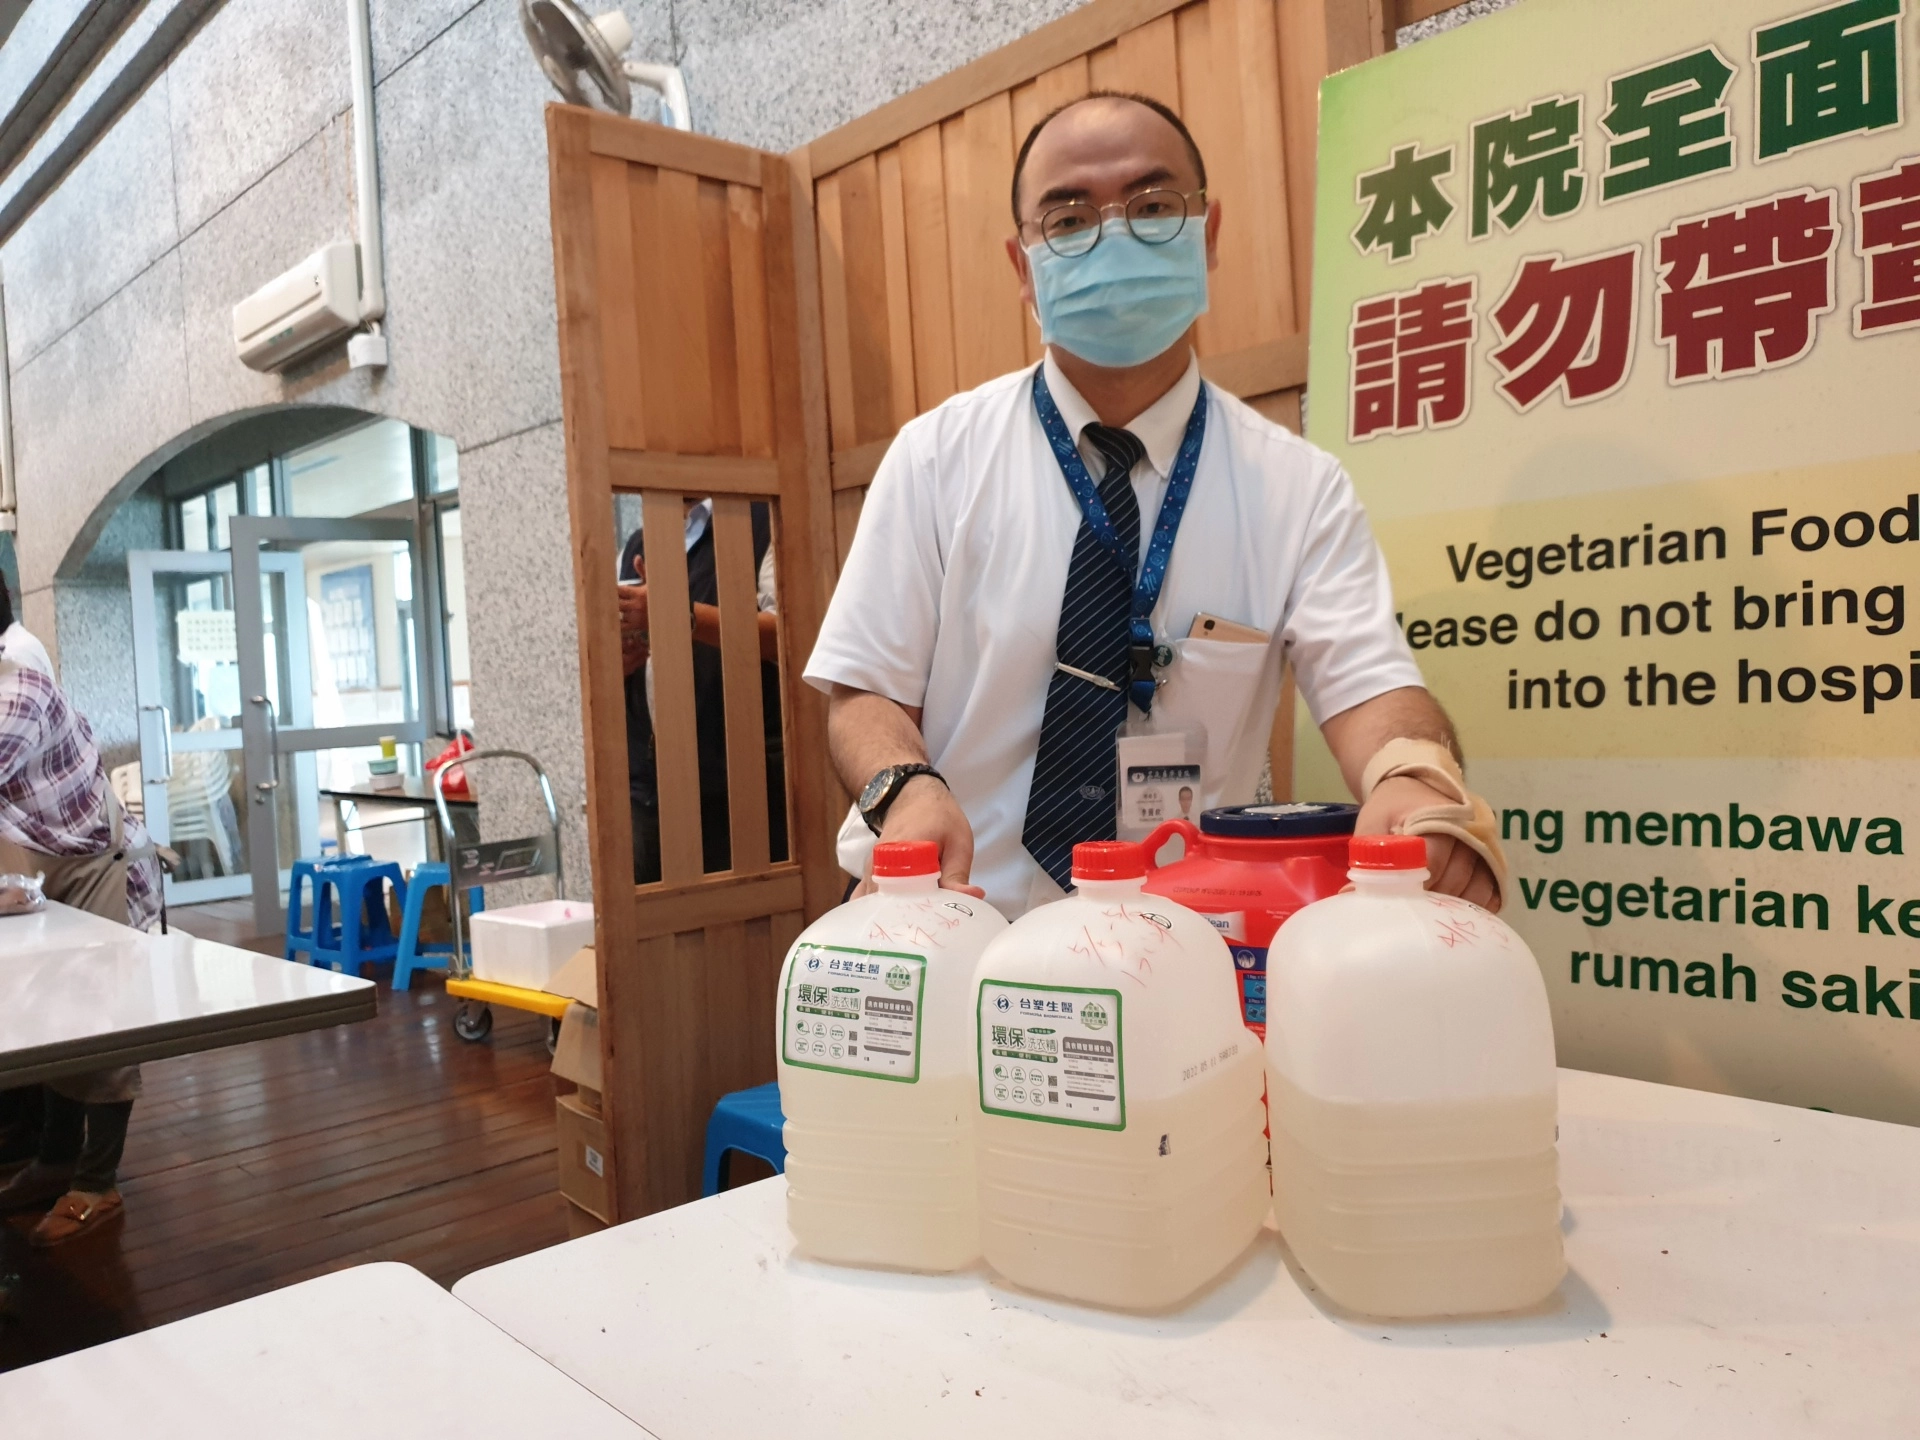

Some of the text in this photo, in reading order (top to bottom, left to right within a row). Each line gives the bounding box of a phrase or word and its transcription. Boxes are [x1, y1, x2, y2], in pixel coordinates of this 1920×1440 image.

[1352, 0, 1902, 260] 本院全面
[1447, 494, 1919, 589] Vegetarian Food
[1395, 580, 1904, 650] ease do not bring
[1509, 651, 1920, 714] into the hospi
[1492, 803, 1904, 855] ng membawa
[1205, 915, 1230, 929] lean
[1519, 877, 1920, 938] vegetarian ke
[829, 959, 880, 975] 台塑生醫
[1571, 951, 1920, 1020] rumah saki
[798, 984, 860, 1011] 環保 洗衣精
[1020, 998, 1073, 1013] 台塑生醫
[992, 1025, 1057, 1053] 環保 洗衣精
